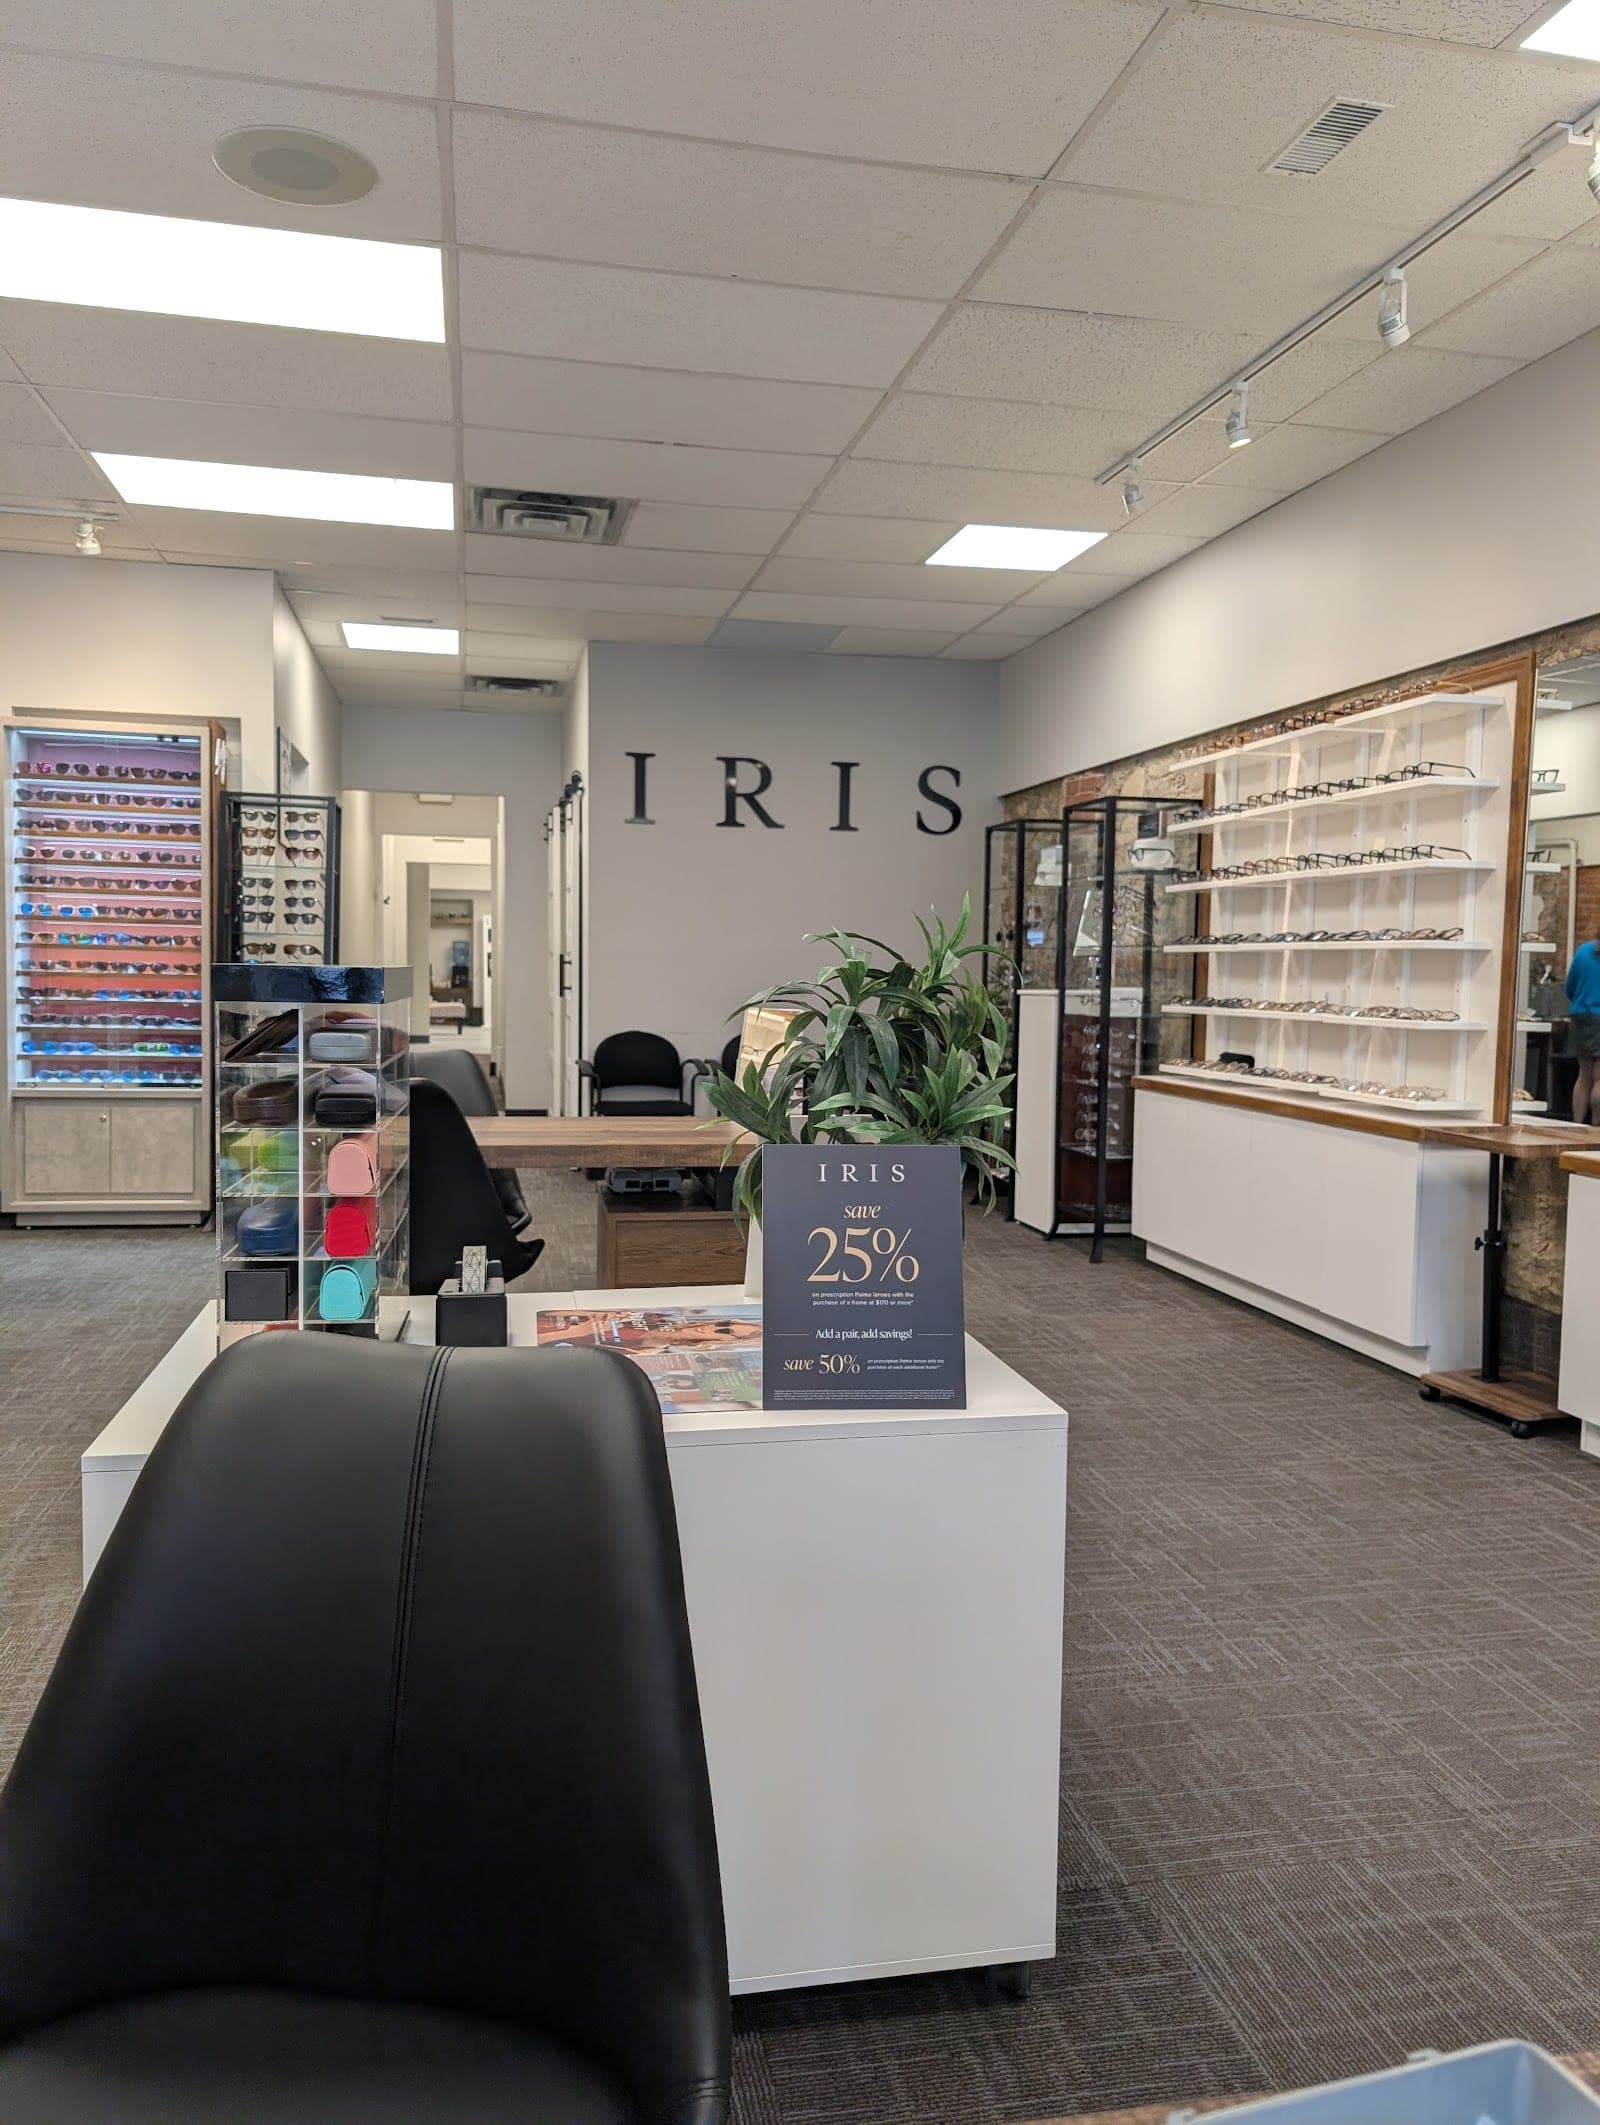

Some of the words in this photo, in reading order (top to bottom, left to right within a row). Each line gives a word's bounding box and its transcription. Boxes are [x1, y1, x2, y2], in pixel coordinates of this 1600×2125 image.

[625, 752, 962, 836] IRIS
[818, 1163, 906, 1183] IRIS
[843, 1204, 881, 1219] save
[807, 1227, 920, 1283] 25%
[820, 1291, 854, 1299] prescription
[815, 1328, 834, 1339] Add
[834, 1331, 841, 1339] a
[841, 1328, 861, 1341] pair,
[860, 1328, 878, 1339] add
[879, 1328, 913, 1341] savings!
[783, 1357, 814, 1372] save
[818, 1354, 861, 1375] 50%
